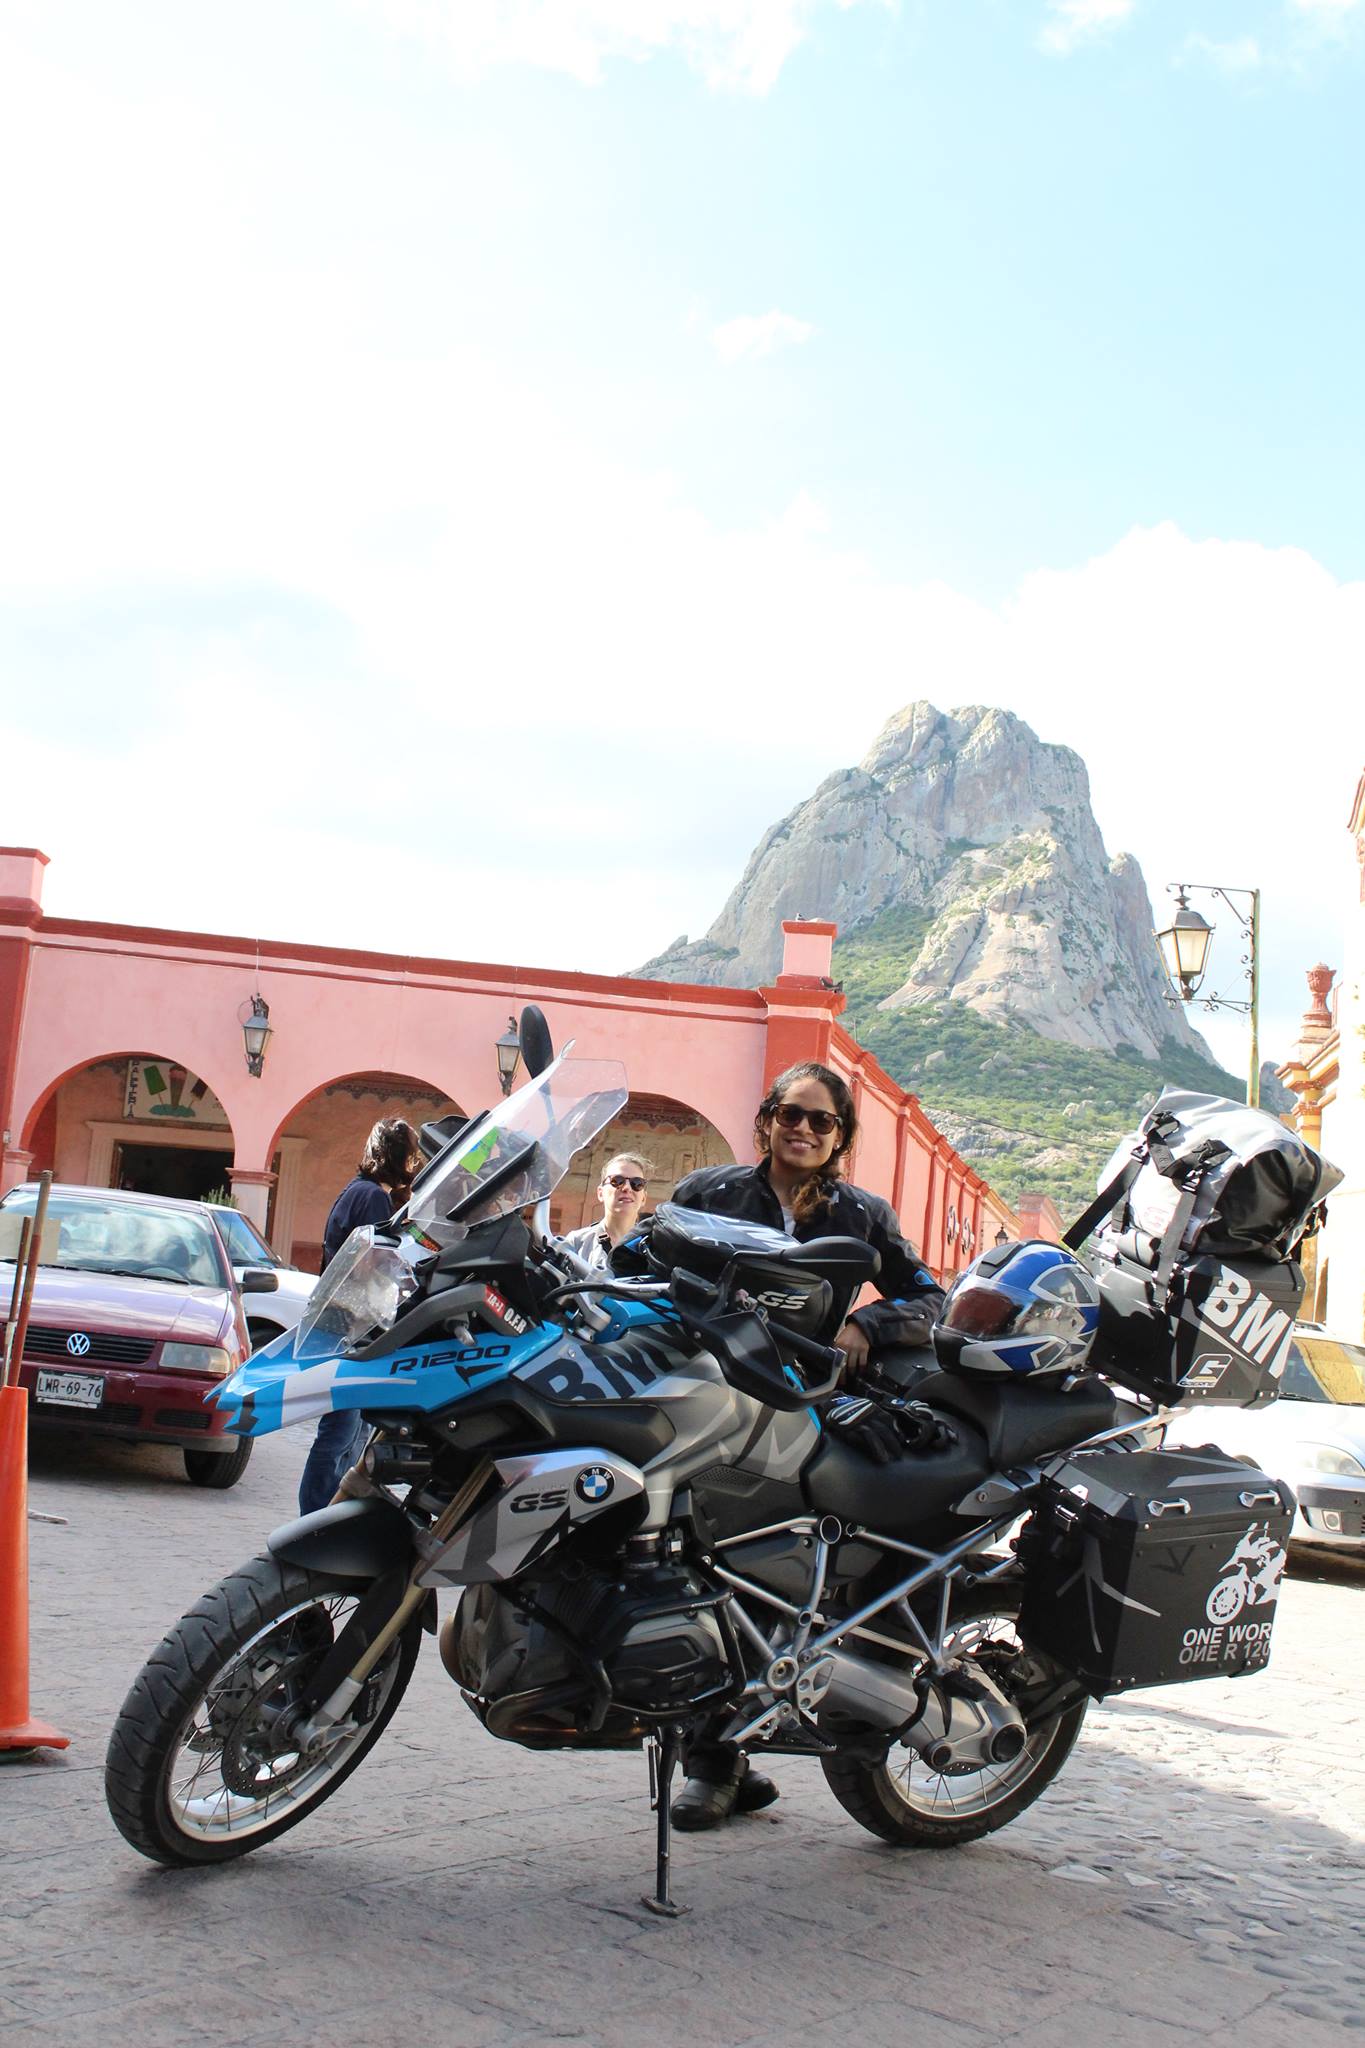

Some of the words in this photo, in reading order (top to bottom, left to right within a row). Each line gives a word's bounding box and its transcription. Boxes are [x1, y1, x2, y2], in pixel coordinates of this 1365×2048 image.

[757, 1291, 809, 1310] GS
[390, 1344, 511, 1375] R1200
[38, 1377, 101, 1399] LWR-69-76
[510, 1489, 569, 1514] GS
[1183, 1627, 1224, 1646] ONE
[1223, 1643, 1238, 1660] R
